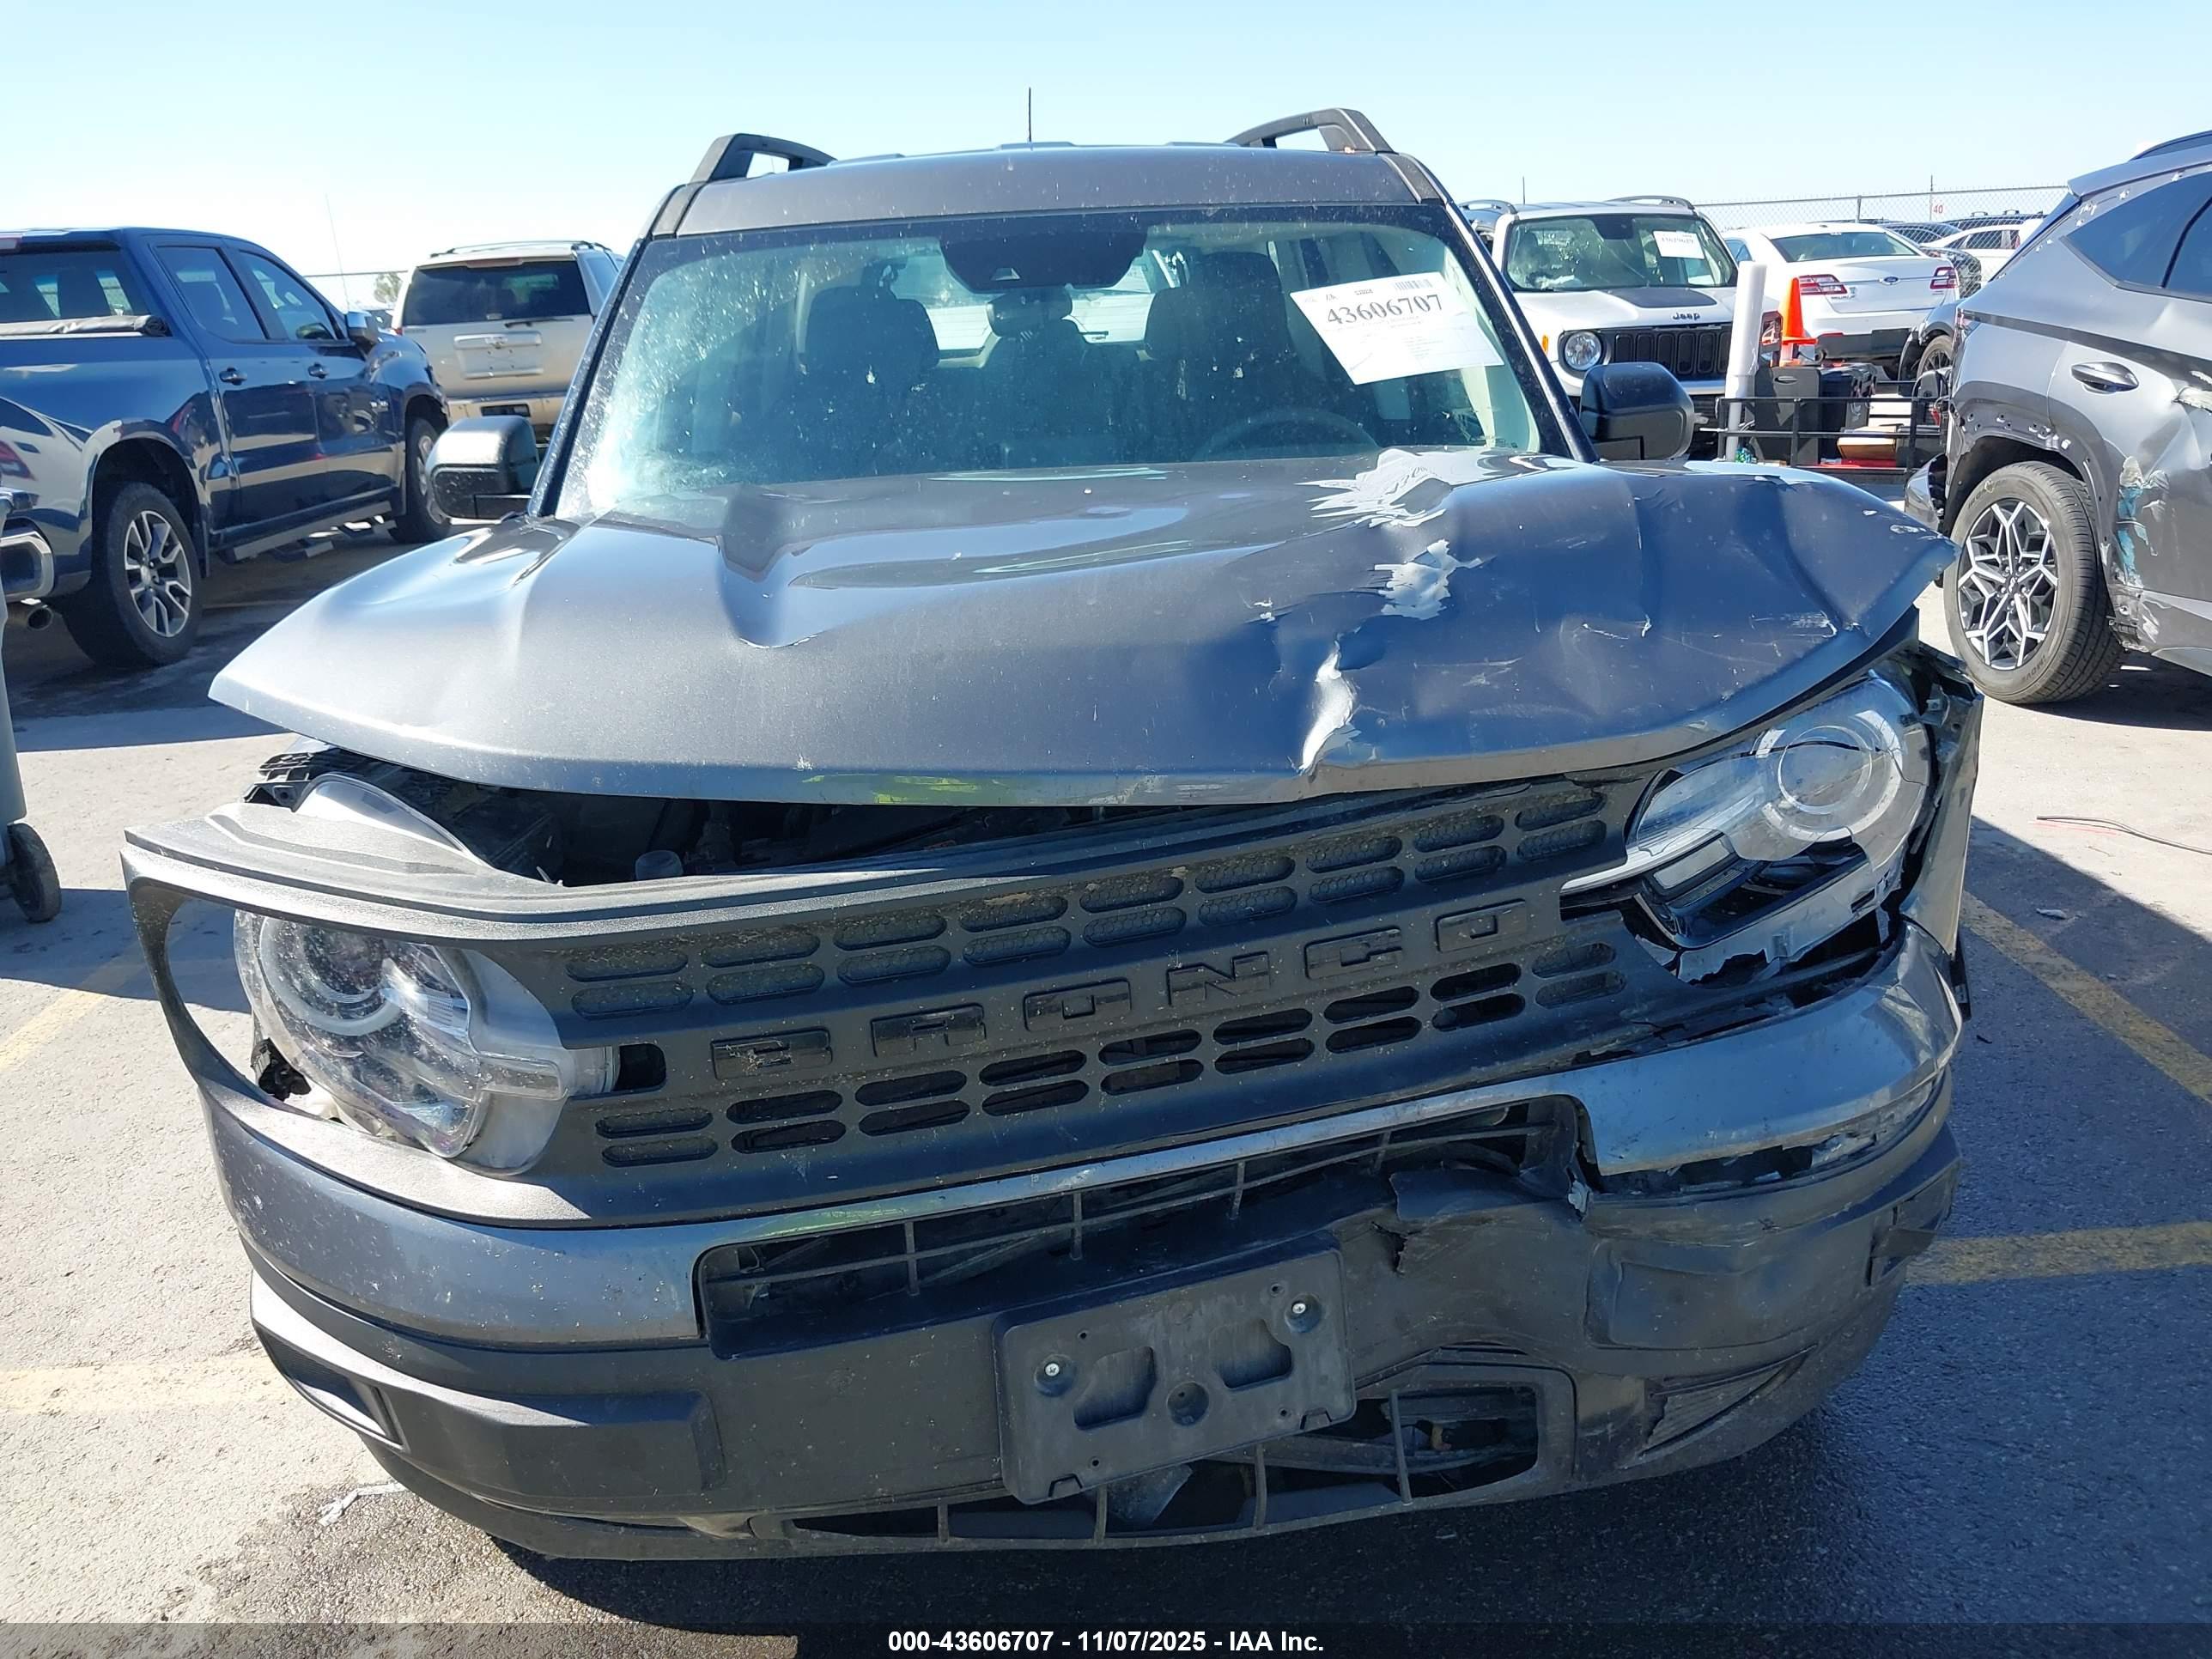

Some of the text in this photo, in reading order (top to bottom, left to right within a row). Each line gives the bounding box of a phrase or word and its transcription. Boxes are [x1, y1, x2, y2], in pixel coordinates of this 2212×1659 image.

[1328, 294, 1443, 324] 43606707
[1673, 312, 1701, 321] Jeep
[710, 898, 1527, 1080] BRONCO
